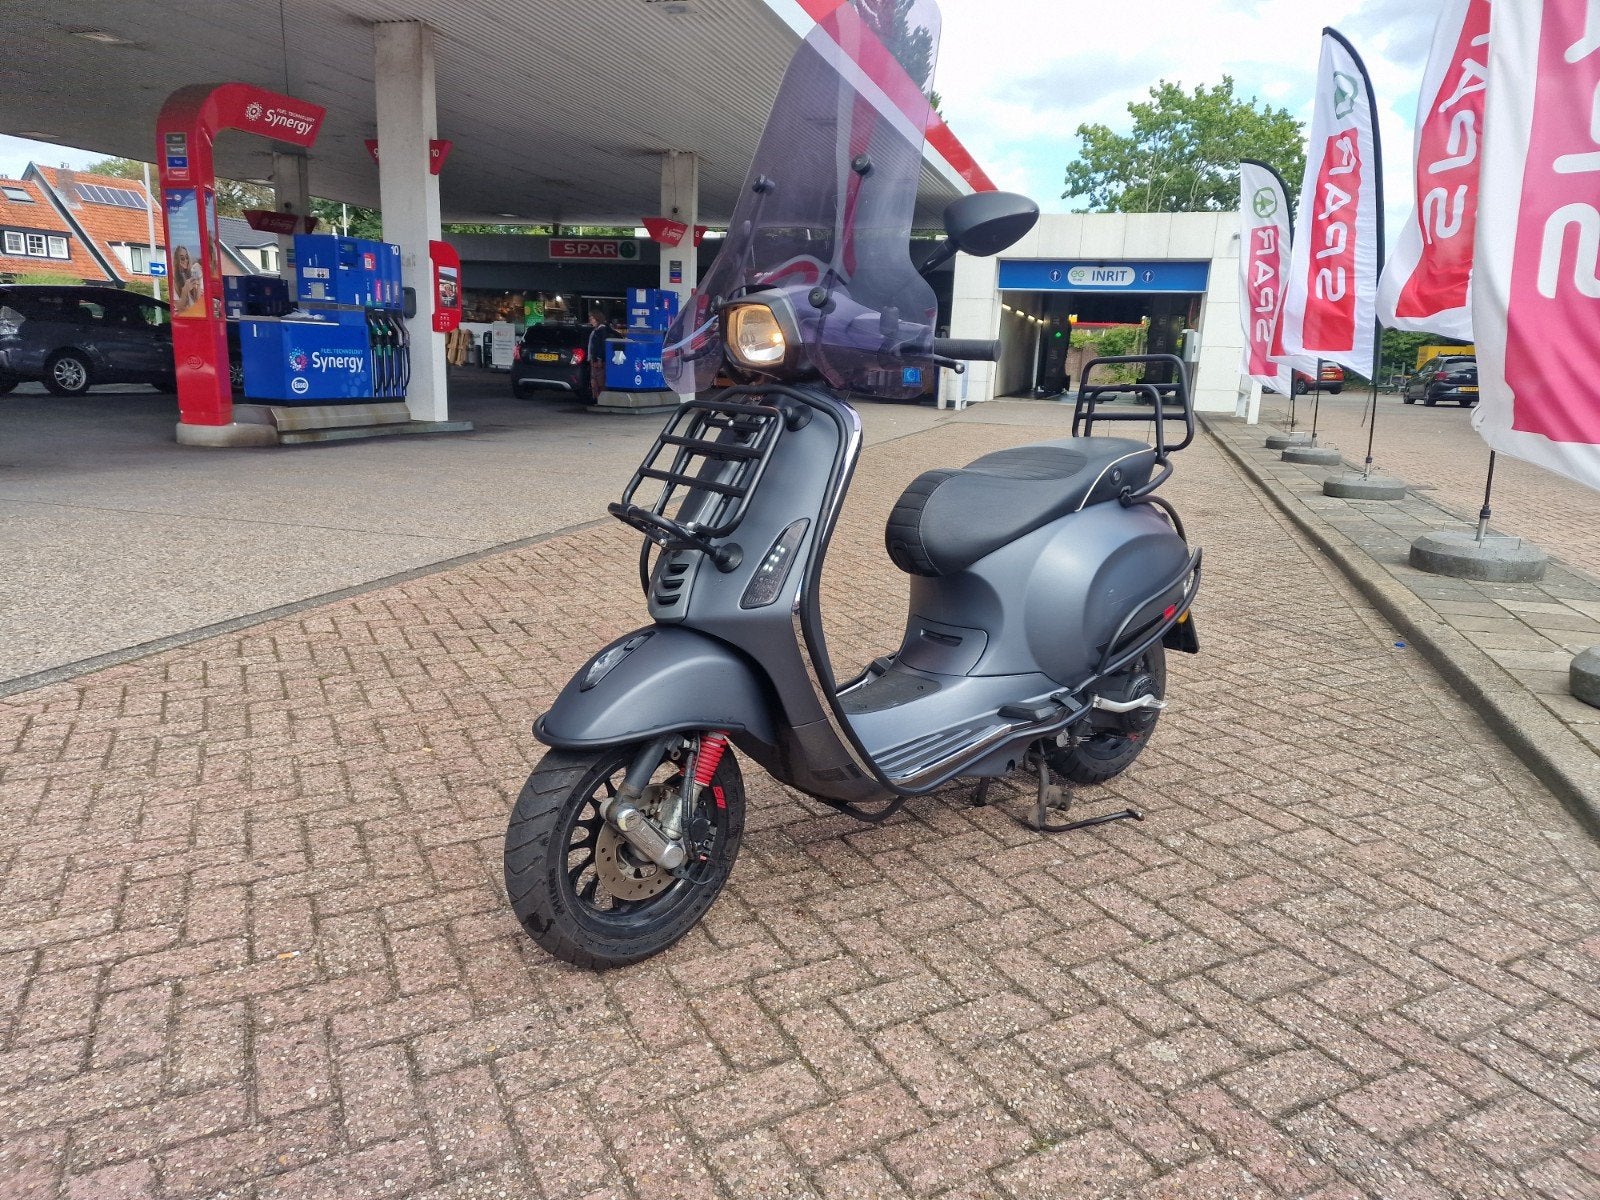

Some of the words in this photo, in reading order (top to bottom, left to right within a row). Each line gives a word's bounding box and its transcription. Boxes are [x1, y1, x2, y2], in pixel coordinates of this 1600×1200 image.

[265, 109, 313, 135] Synergy
[430, 149, 440, 157] 10
[391, 245, 400, 255] 10
[564, 243, 616, 254] SPAR
[1091, 270, 1128, 282] INRIT
[311, 351, 364, 373] Synergy
[642, 360, 662, 373] Synergy
